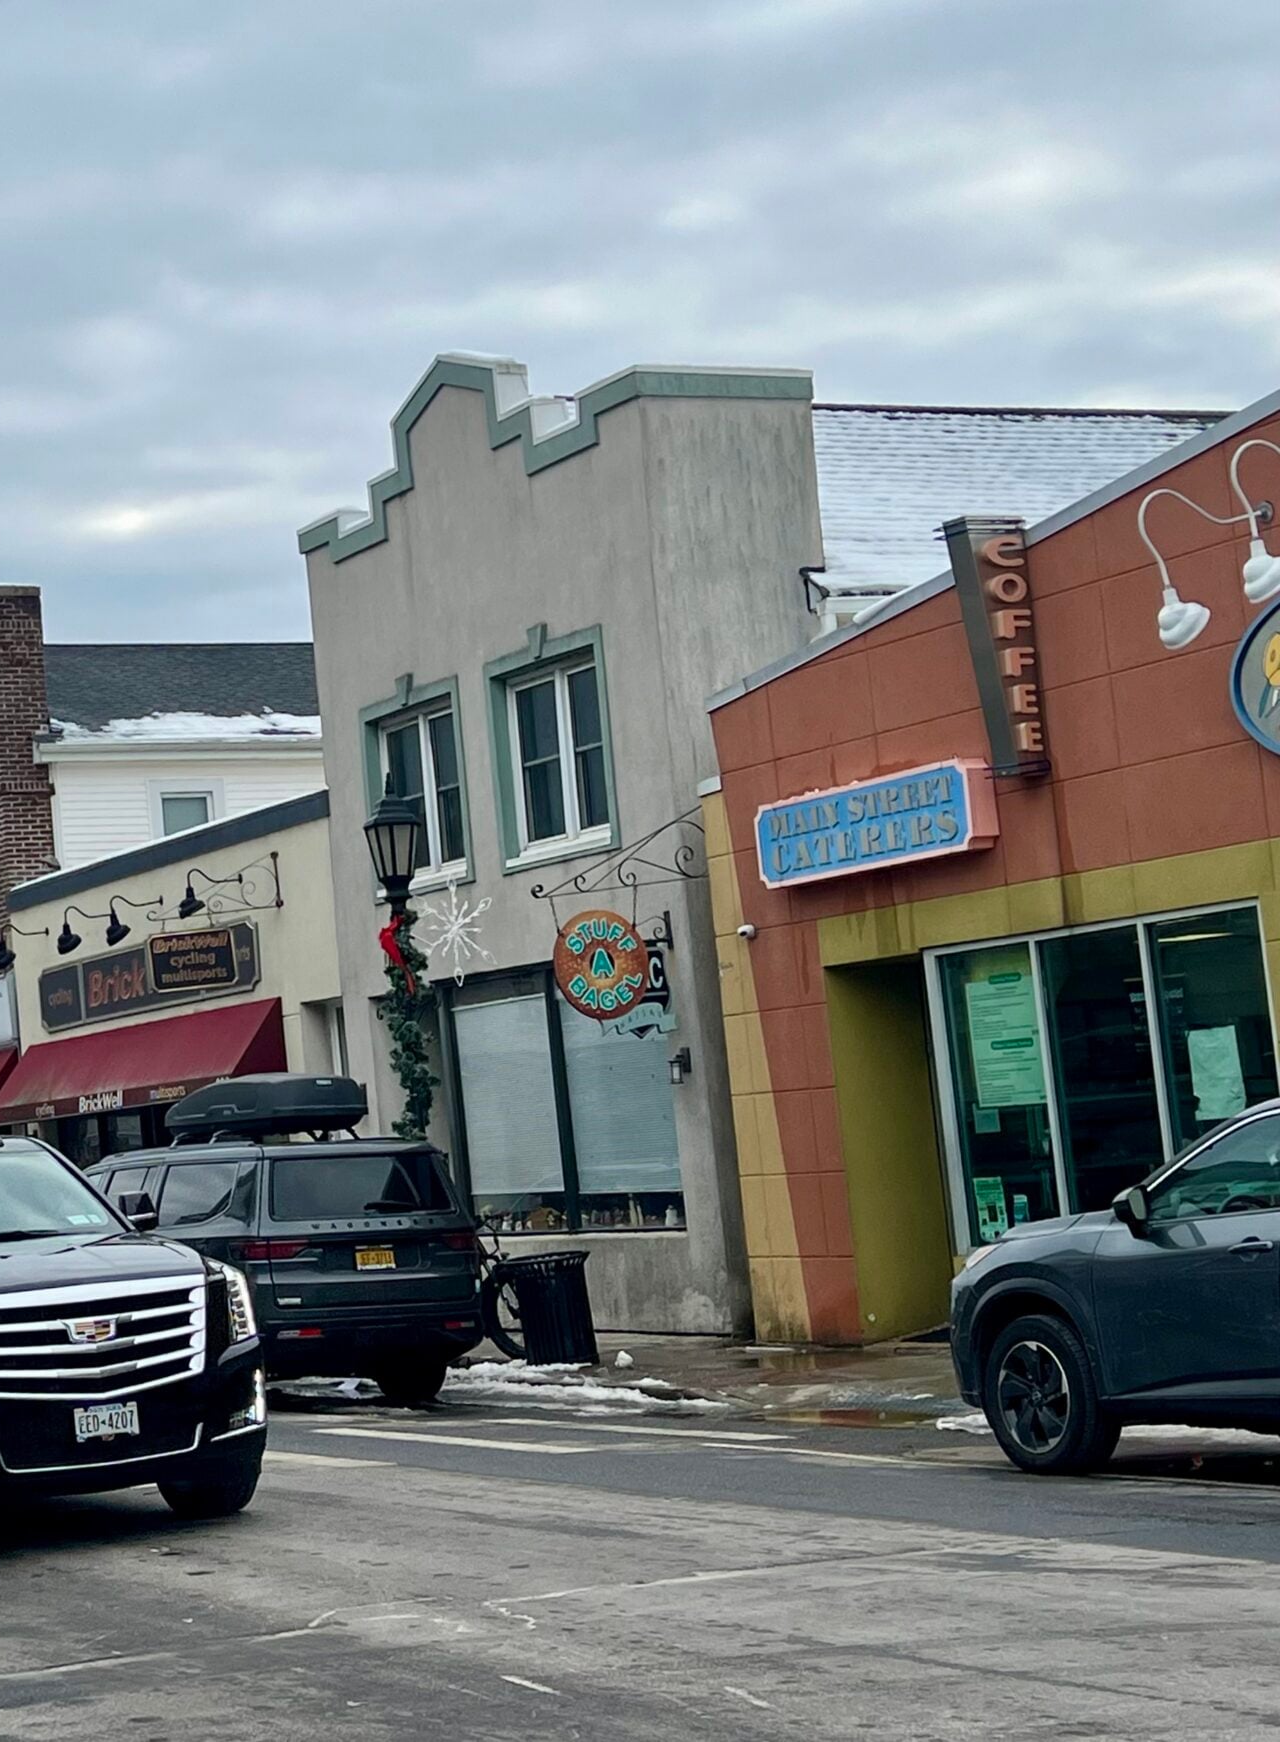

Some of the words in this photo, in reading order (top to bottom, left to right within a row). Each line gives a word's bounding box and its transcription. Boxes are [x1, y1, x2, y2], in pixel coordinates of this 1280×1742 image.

[982, 536, 1044, 752] COFFEE
[770, 800, 840, 842] MAIN
[846, 774, 954, 825] STREET
[772, 809, 960, 875] CATERERS
[566, 919, 638, 955] STUFF
[161, 966, 228, 984] multisports
[169, 951, 216, 969] cycling
[591, 948, 615, 978] A
[88, 956, 145, 1008] Brick
[568, 972, 643, 1010] BAGEL
[78, 1088, 124, 1114] BrickWell
